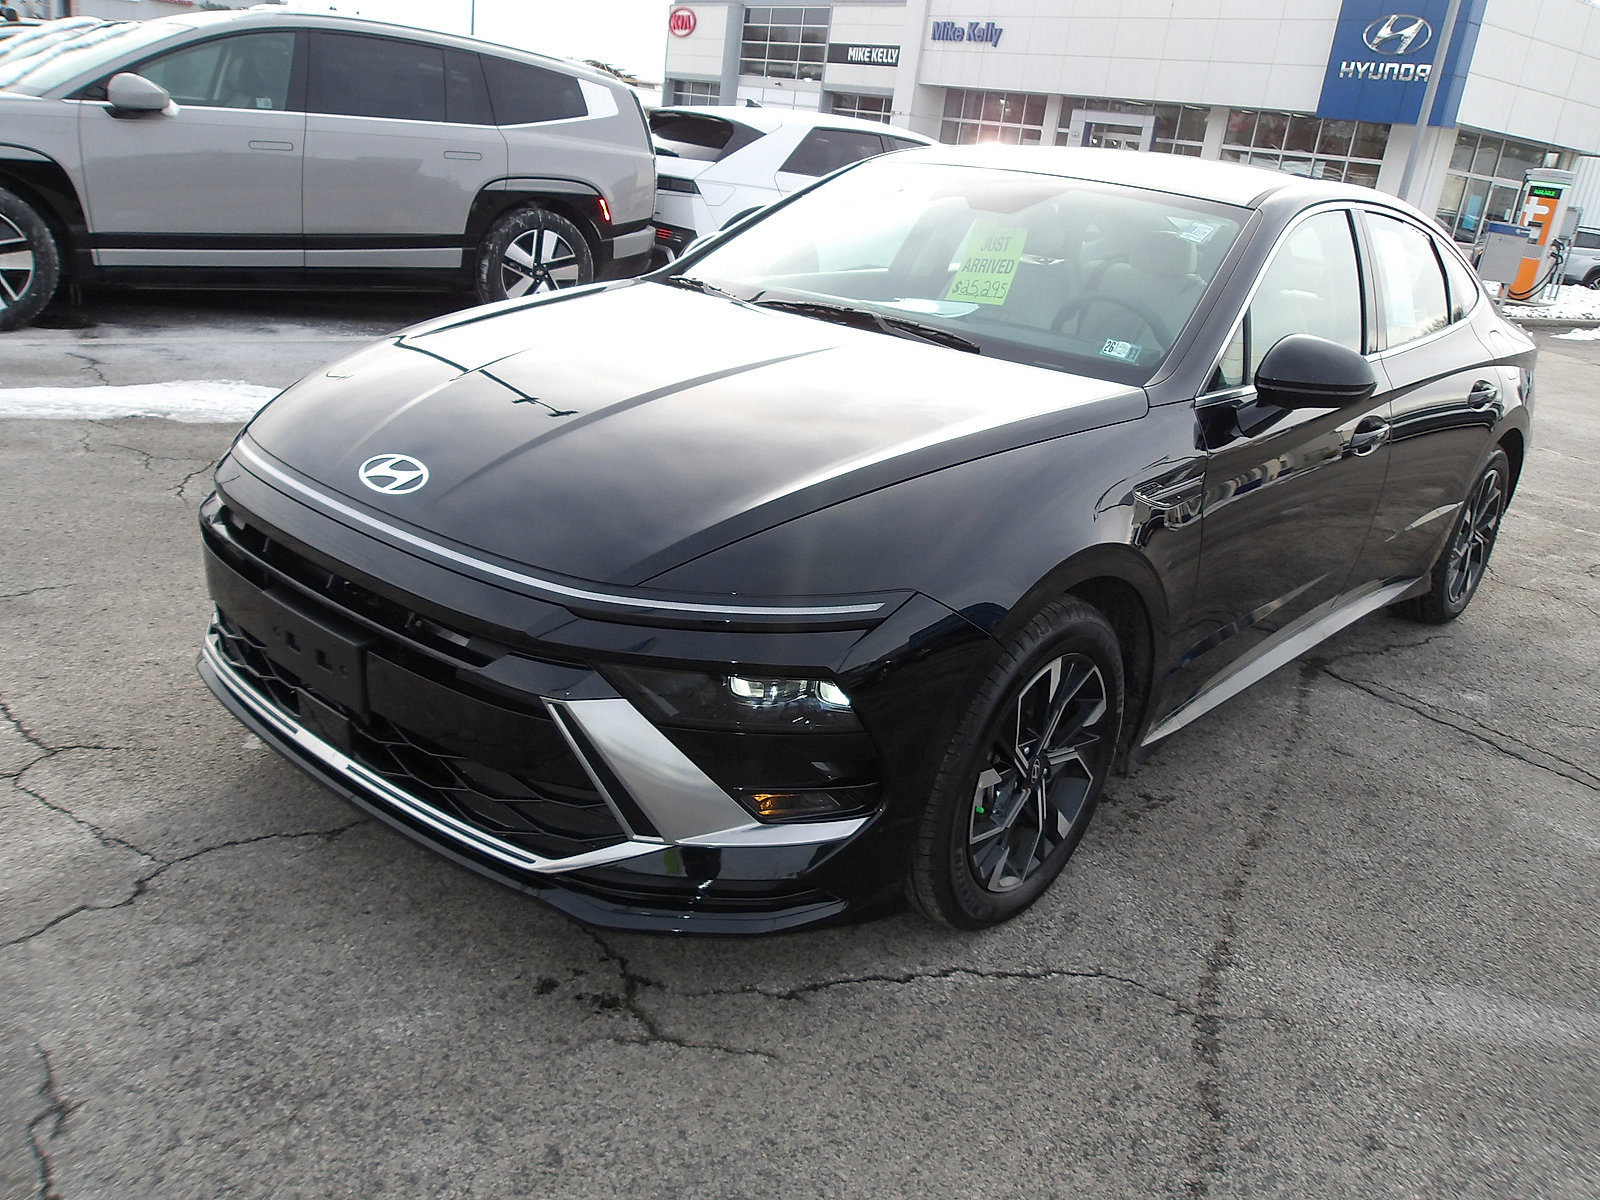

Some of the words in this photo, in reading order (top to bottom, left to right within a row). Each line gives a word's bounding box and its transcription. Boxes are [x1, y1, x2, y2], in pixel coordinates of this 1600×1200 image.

[671, 14, 692, 31] KIA
[931, 21, 965, 41] Mike
[966, 22, 1003, 48] Kelly
[847, 47, 871, 62] MIKE
[871, 48, 899, 63] KELLY
[1339, 60, 1433, 83] HYUNDA
[980, 237, 1012, 252] JUST
[961, 258, 1015, 274] ARRIVED
[952, 279, 1008, 299] $25,295
[1103, 340, 1117, 353] 26
